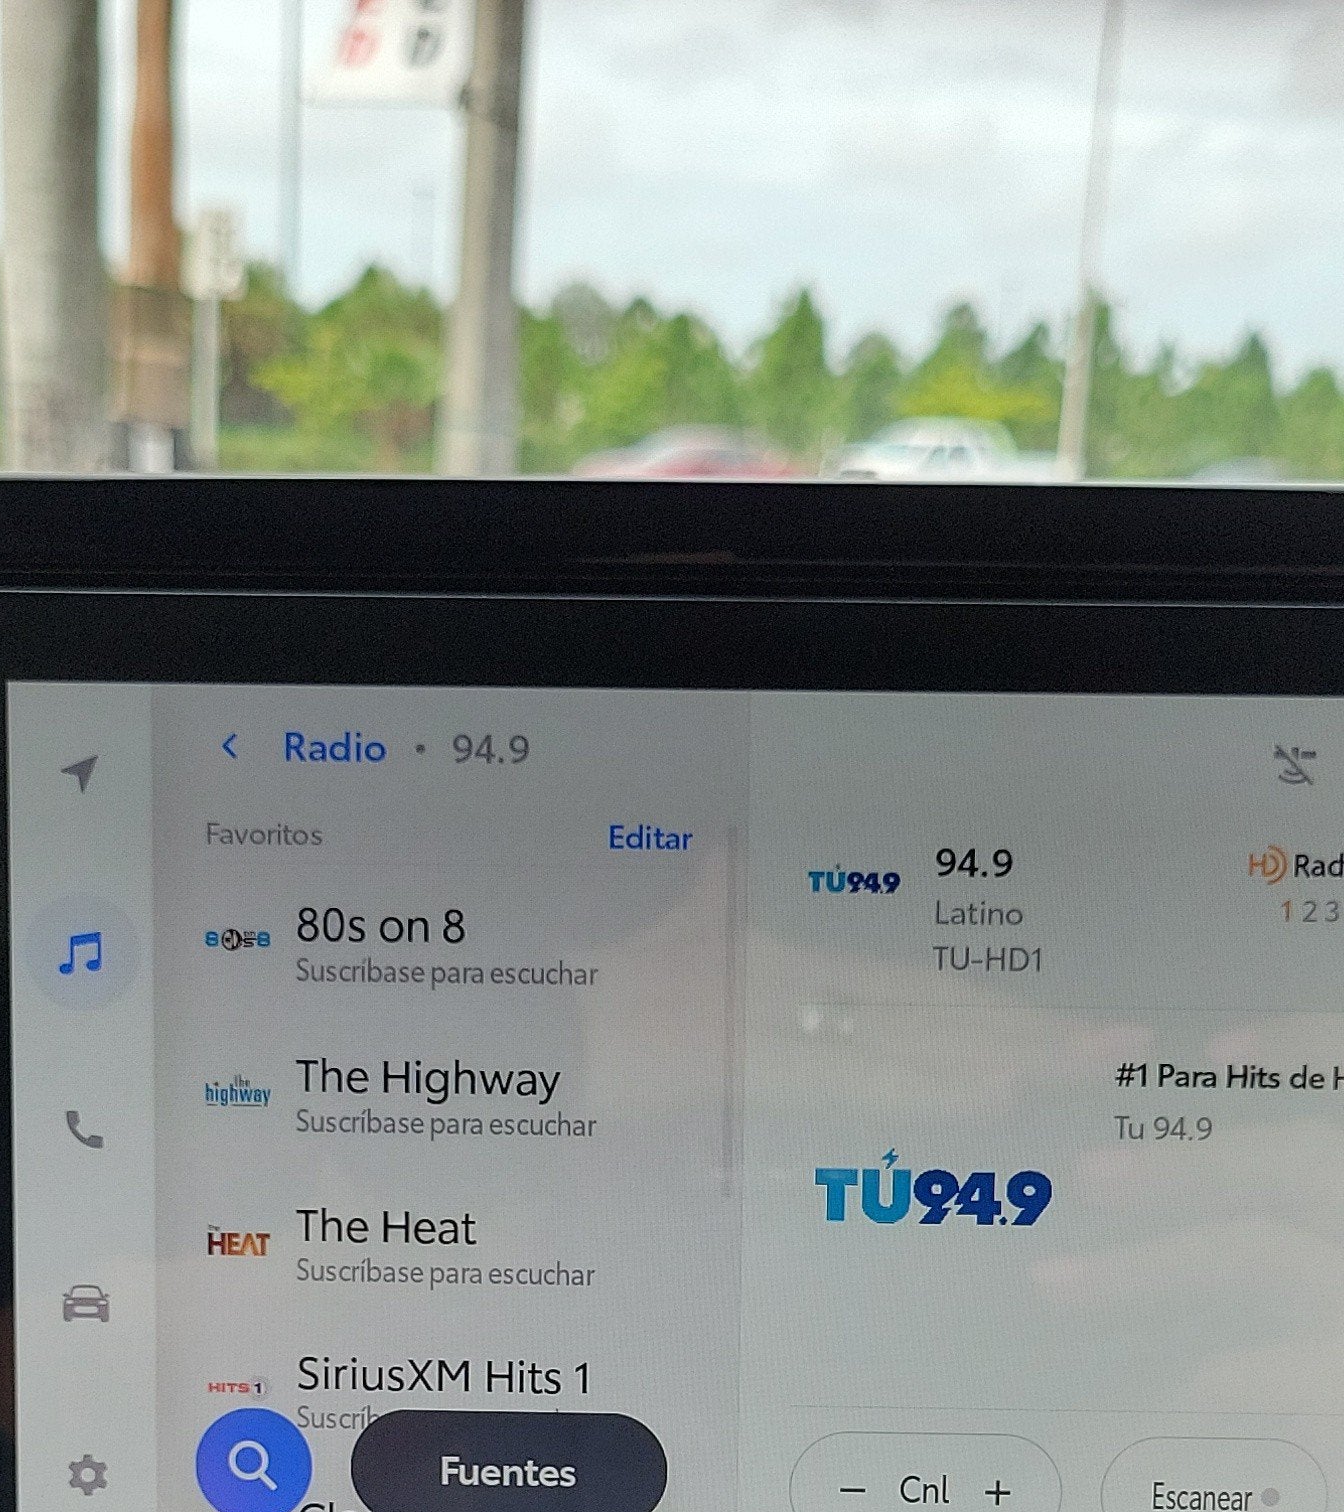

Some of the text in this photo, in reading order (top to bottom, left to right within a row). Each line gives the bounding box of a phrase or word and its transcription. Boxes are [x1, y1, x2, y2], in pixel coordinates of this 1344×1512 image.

[284, 732, 530, 765] Radio 94.9
[207, 822, 323, 847] Favoritos
[609, 825, 694, 852] Editar
[936, 848, 1013, 878] 94.9
[297, 908, 466, 944] 80s on 8
[936, 901, 1023, 926] Latino
[296, 957, 599, 991] Suscríbase para escuchar
[932, 946, 1042, 972] TU-HD1
[296, 1058, 561, 1105] The Highway
[1115, 1063, 1149, 1088] #1
[1158, 1064, 1217, 1089] Para
[1227, 1065, 1280, 1090] Hits
[1289, 1065, 1325, 1090] de
[204, 1082, 272, 1108] highway
[296, 1109, 597, 1141] Suscríbase para escuchar
[1114, 1116, 1212, 1141] Tu 94.9
[296, 1208, 477, 1246] The Heat
[207, 1232, 271, 1256] HEAT
[296, 1257, 595, 1290] Suscríbase para escuchar
[207, 1382, 250, 1394] HITS
[298, 1357, 591, 1394] SiriusXM Hits 1
[297, 1404, 378, 1430] Suscríb
[440, 1456, 576, 1487] Fuentes
[899, 1475, 950, 1505] Cnl
[1152, 1481, 1253, 1512] Escanear
